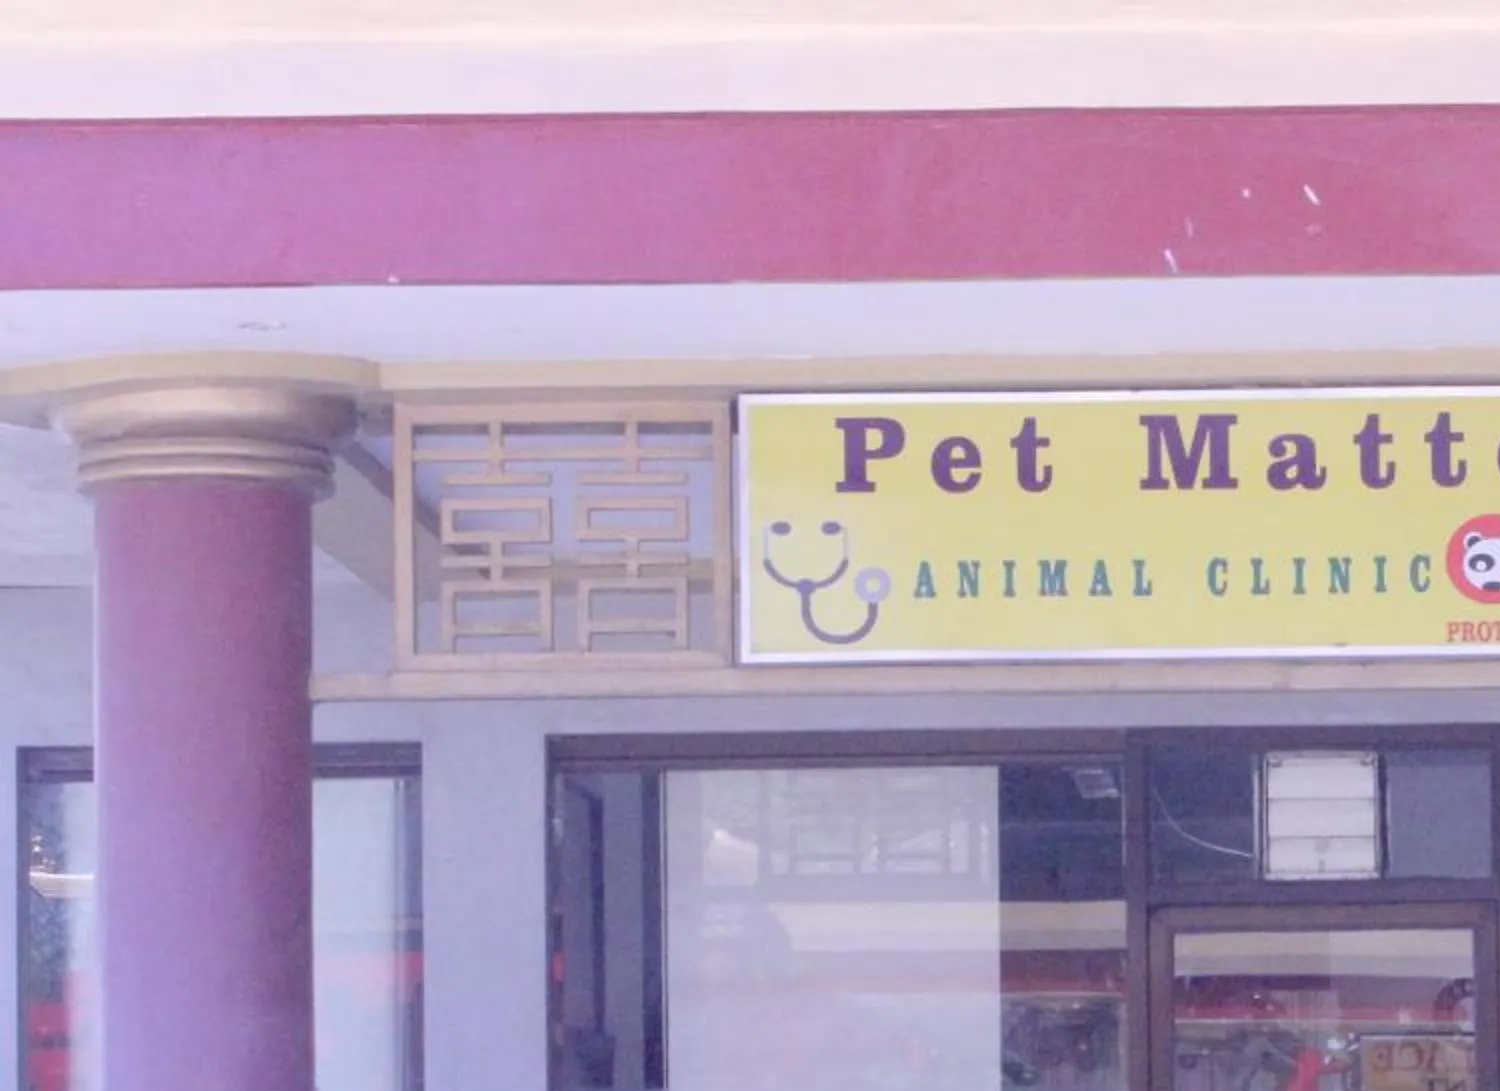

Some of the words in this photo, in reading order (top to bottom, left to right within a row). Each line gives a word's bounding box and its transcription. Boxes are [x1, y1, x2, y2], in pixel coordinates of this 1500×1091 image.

[835, 416, 1053, 493] Pet
[914, 557, 1152, 599] ANIMAL
[1207, 553, 1432, 597] CLINIC
